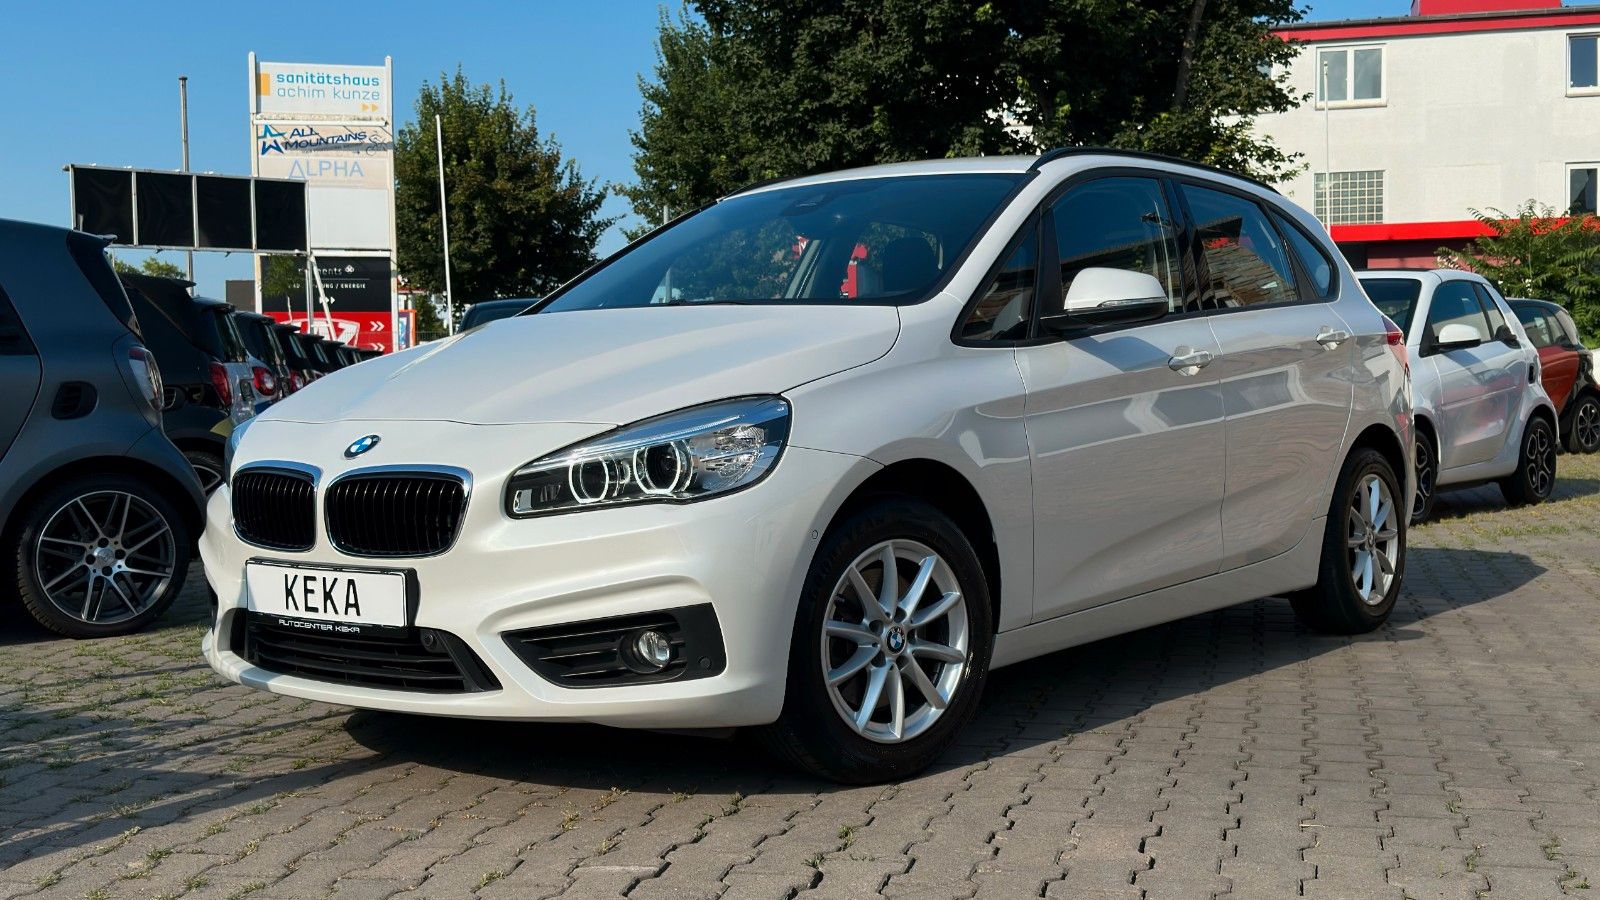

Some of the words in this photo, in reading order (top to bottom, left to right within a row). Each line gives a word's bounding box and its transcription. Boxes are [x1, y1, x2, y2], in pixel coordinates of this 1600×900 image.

[276, 72, 380, 87] sanitätshaus
[277, 86, 326, 99] achim
[333, 87, 380, 101] kunze
[289, 127, 320, 139] ALL
[284, 131, 367, 151] MOUNTAINS
[284, 573, 361, 617] KEKA
[278, 618, 333, 632] AUTOCENTER
[334, 625, 361, 634] KEKA
